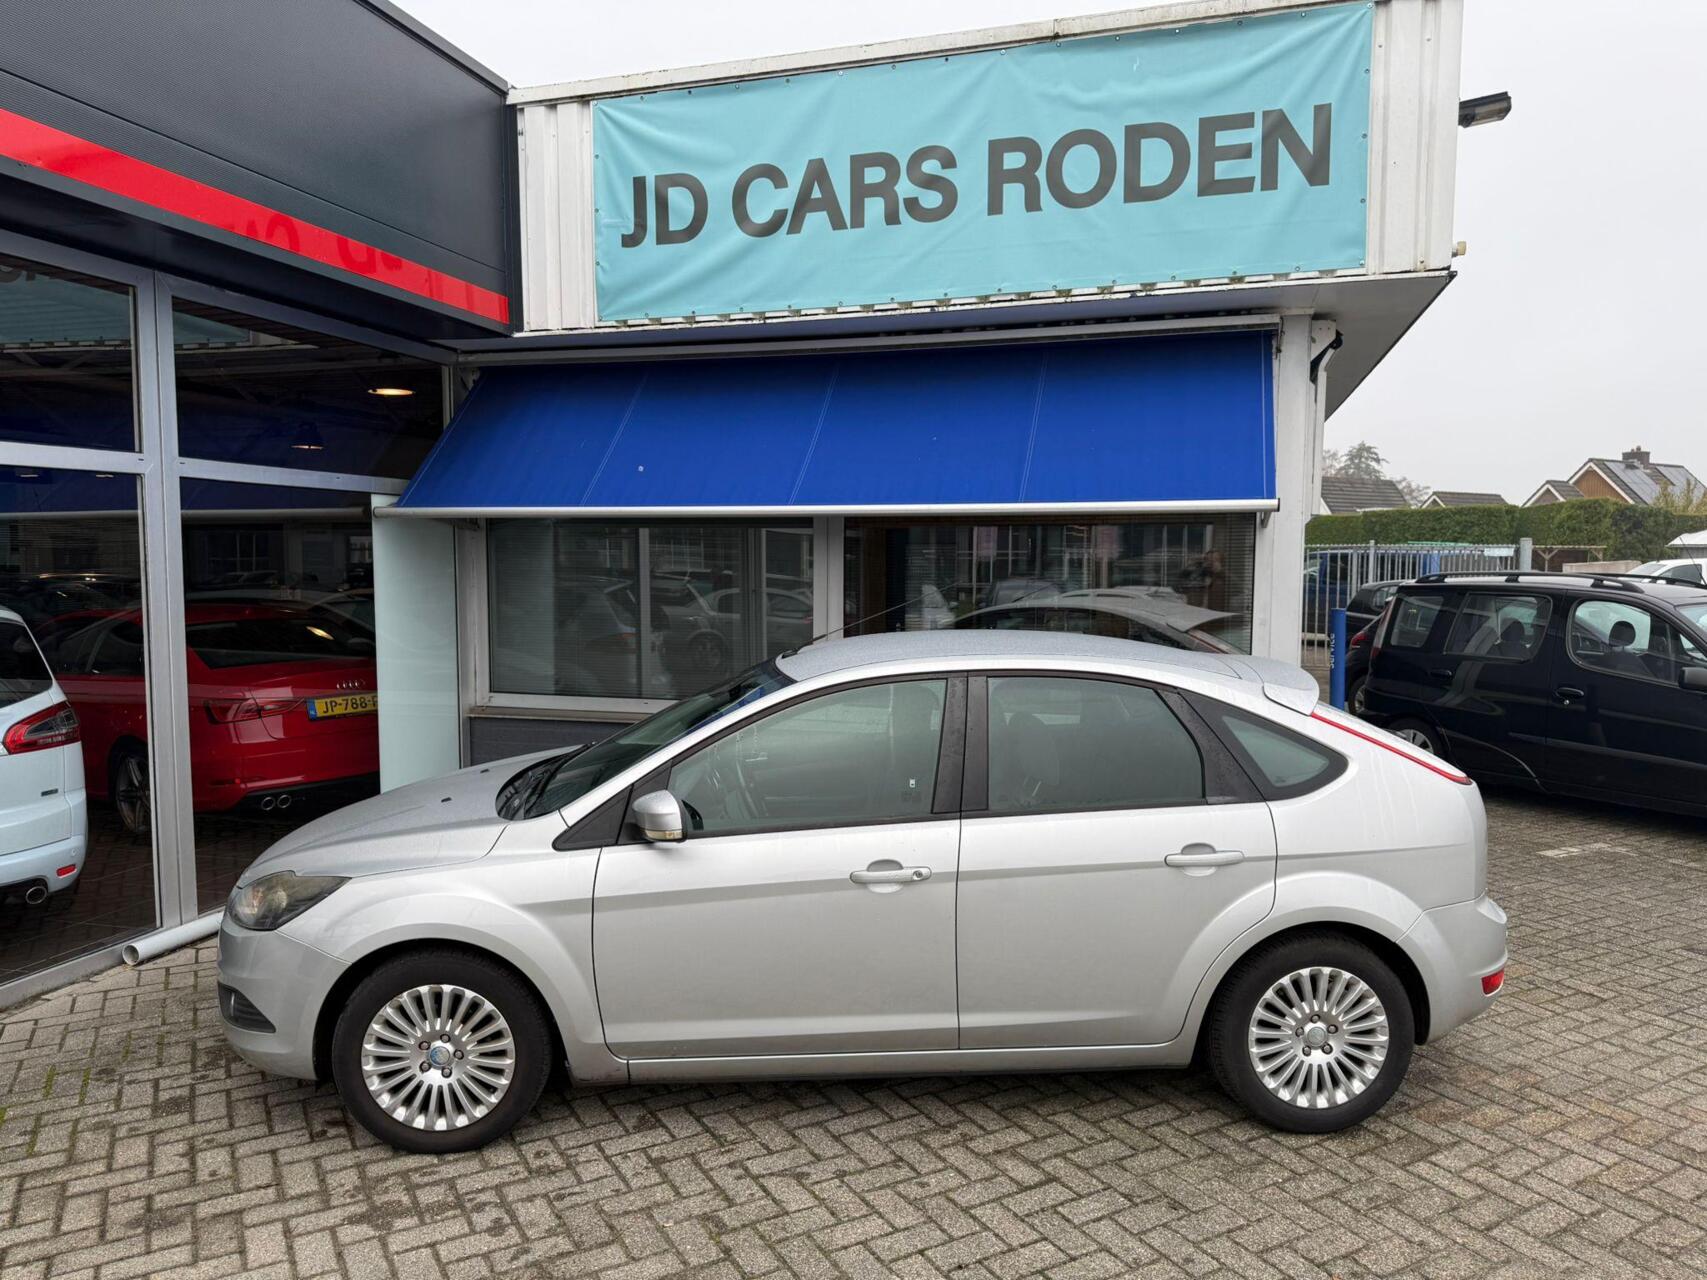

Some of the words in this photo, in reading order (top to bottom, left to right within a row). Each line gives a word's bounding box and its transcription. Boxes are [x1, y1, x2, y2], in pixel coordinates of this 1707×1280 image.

[621, 174, 708, 249] JD
[732, 146, 958, 238] CARS
[988, 103, 1332, 216] RODEN
